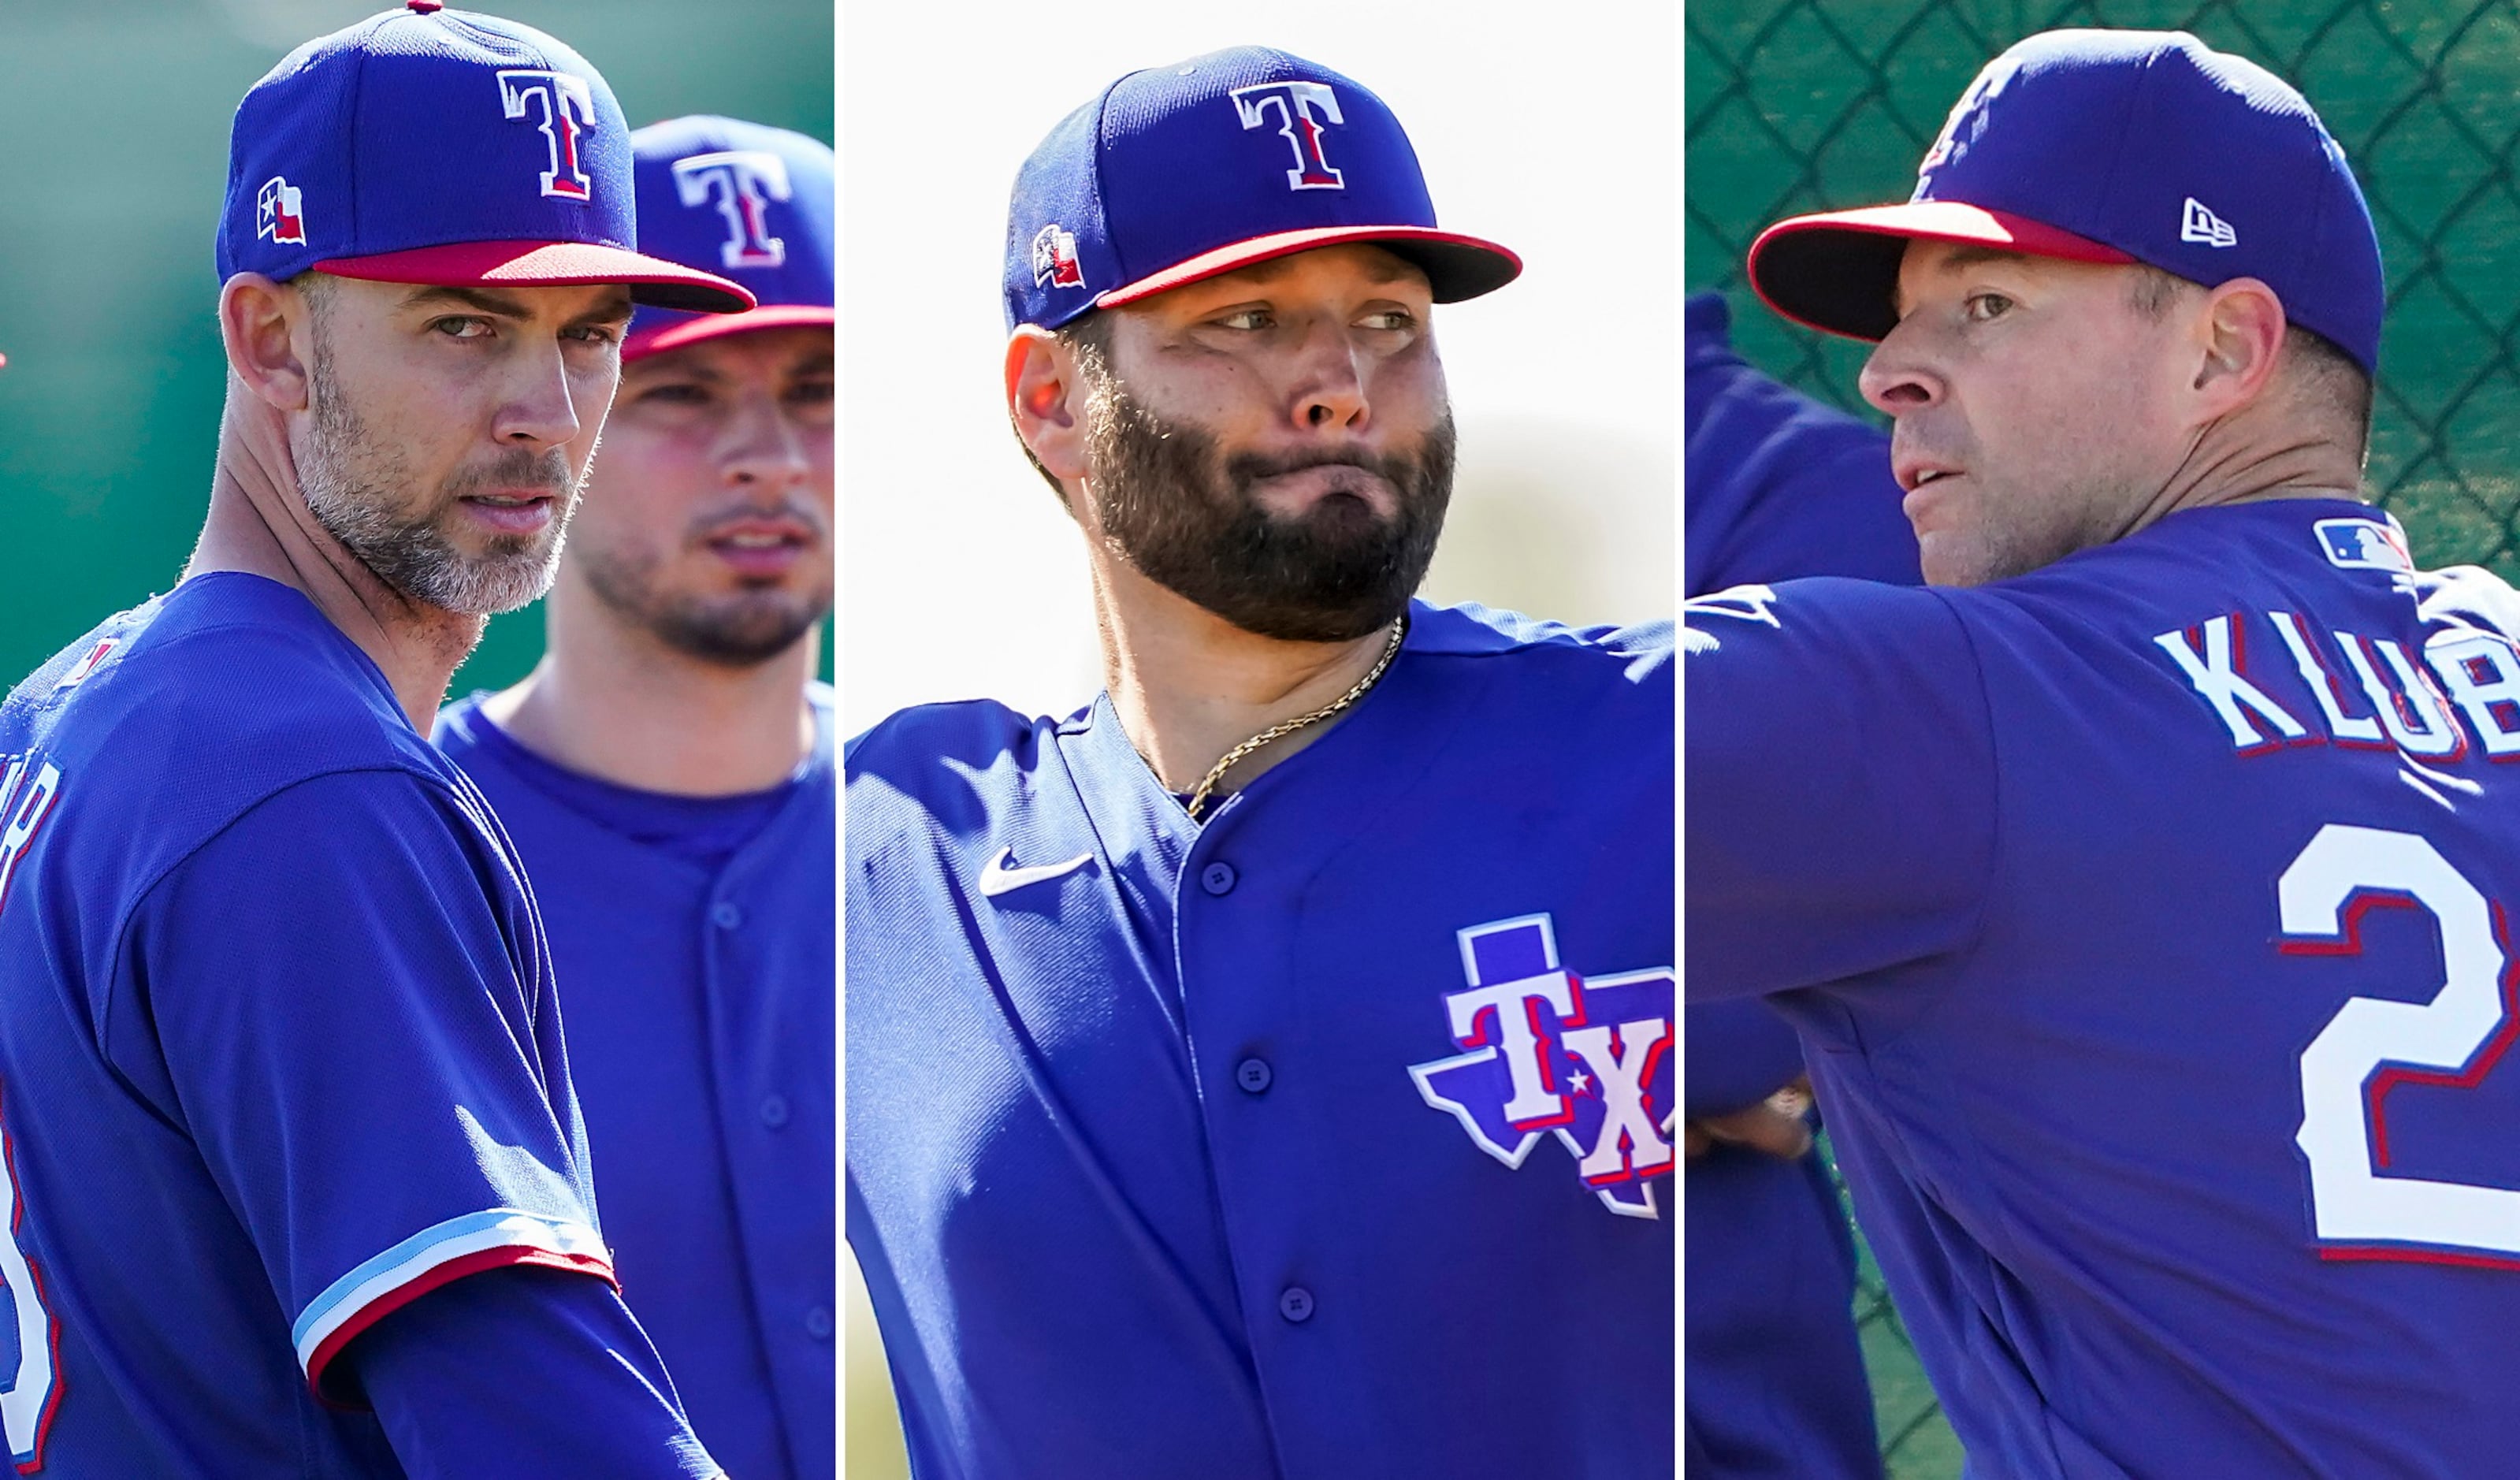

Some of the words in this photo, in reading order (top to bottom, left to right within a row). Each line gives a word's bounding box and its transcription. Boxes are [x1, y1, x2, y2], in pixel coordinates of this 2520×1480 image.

[496, 70, 596, 201] T
[1228, 81, 1344, 192] T
[672, 151, 791, 268] T
[1445, 968, 1674, 1185] TX
[2277, 824, 2520, 1269] 2
